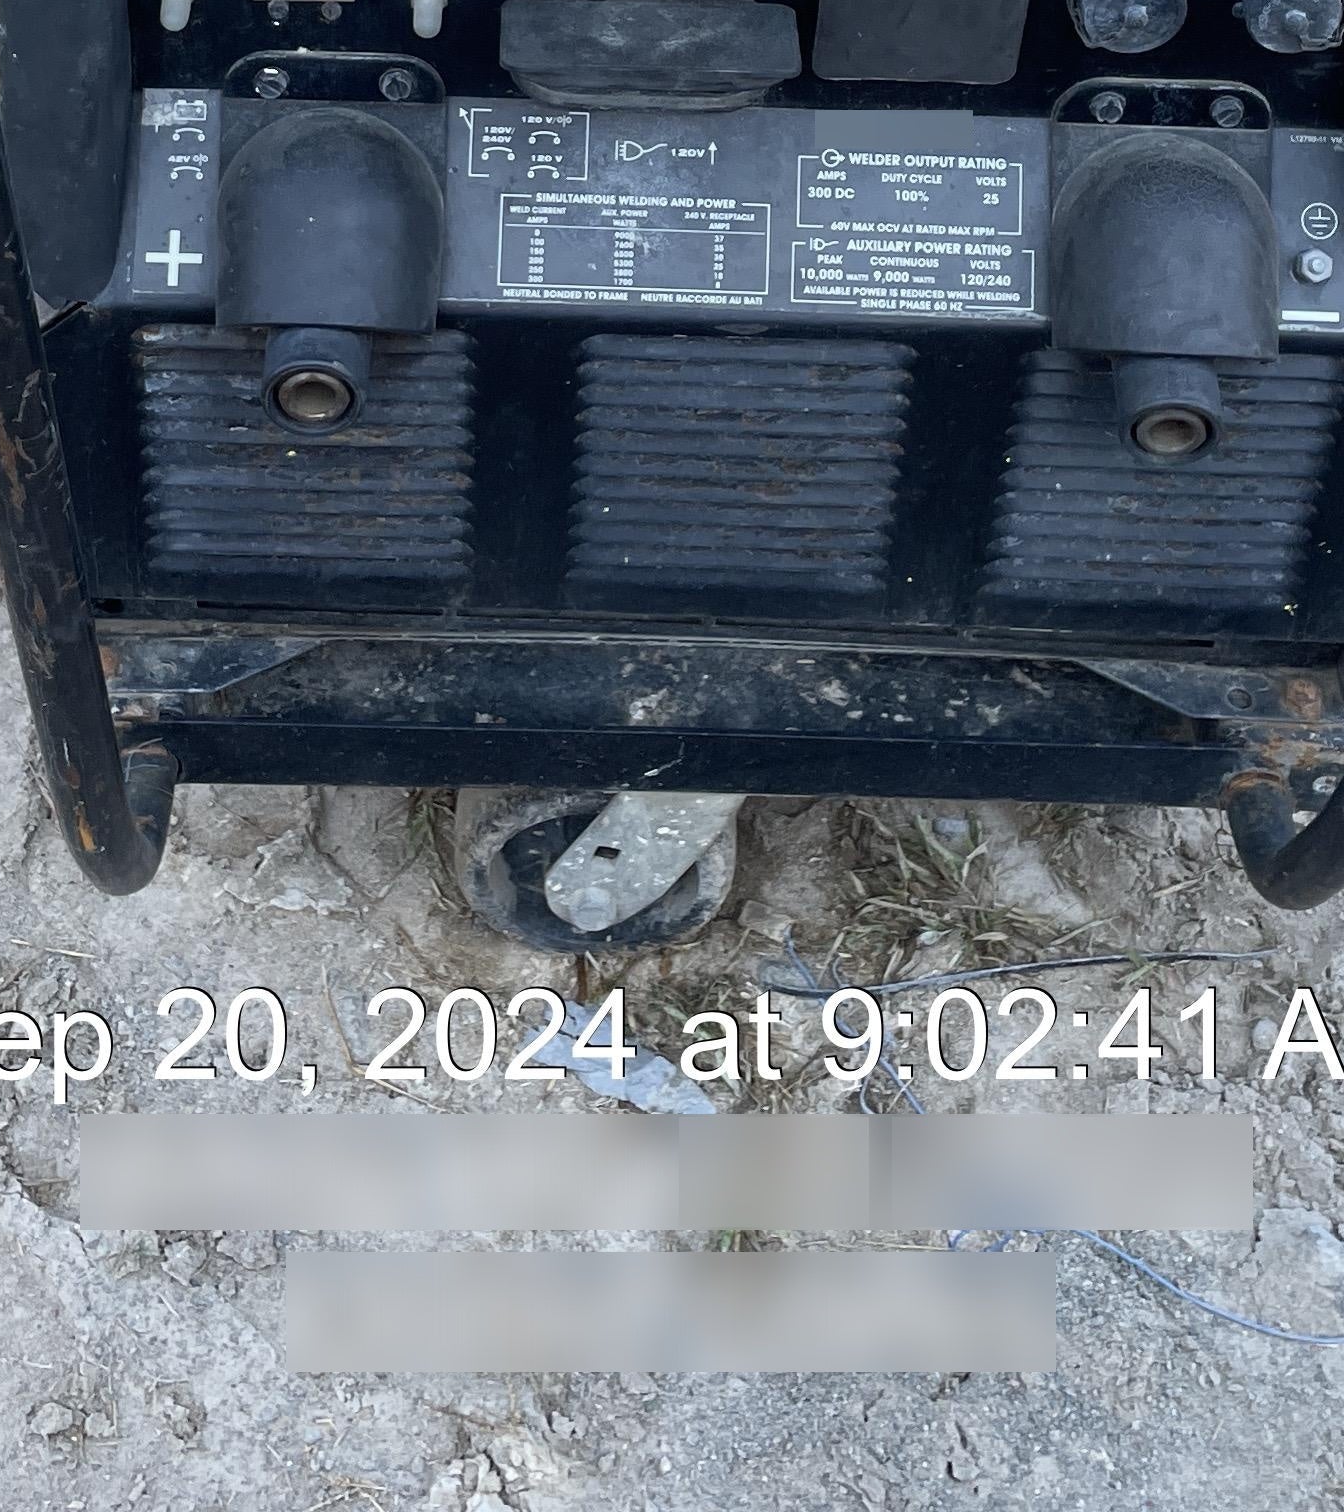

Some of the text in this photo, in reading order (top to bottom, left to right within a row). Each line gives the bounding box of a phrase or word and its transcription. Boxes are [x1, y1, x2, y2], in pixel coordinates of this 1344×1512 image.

[671, 149, 705, 157] 120V
[849, 152, 1007, 170] WELDER OUTPUT RATING
[817, 171, 847, 180] AMPS
[882, 173, 942, 184] DUTY CYCLE
[976, 177, 1007, 186] VOLTS
[808, 187, 855, 199] 300 DC
[895, 190, 929, 202] 100%
[536, 193, 736, 209] SIMULTANEOUS WELDING AND POWER
[983, 194, 999, 205] 25
[533, 207, 566, 215] CURRENT
[620, 209, 648, 217] POWER
[710, 213, 755, 221] RECEPTACLE
[853, 222, 874, 231] MAX
[902, 224, 914, 233] AT
[916, 225, 944, 234] RATED
[948, 226, 970, 235] MAX
[973, 227, 994, 236] RPM
[847, 239, 1012, 256] AUXILIARY POWER RATING
[817, 255, 843, 265] PEAK
[870, 256, 939, 268] CONTINUOUS
[970, 260, 1001, 270] VOLTS
[800, 268, 843, 281] 10,000
[874, 271, 909, 283] 9,000
[961, 274, 1011, 287] 120/240
[503, 290, 540, 298] NEUTRAL
[544, 290, 582, 299] BONDED
[585, 291, 595, 299] TO
[599, 292, 628, 301] FRAME
[641, 293, 673, 302] NEUTRE
[729, 296, 741, 304] AU
[803, 286, 1020, 302] AVAILABLE POWER IS REDUCED WHILE WELDING
[861, 300, 896, 309] SINGLE
[899, 300, 931, 310] PHASE
[934, 301, 947, 310] 60
